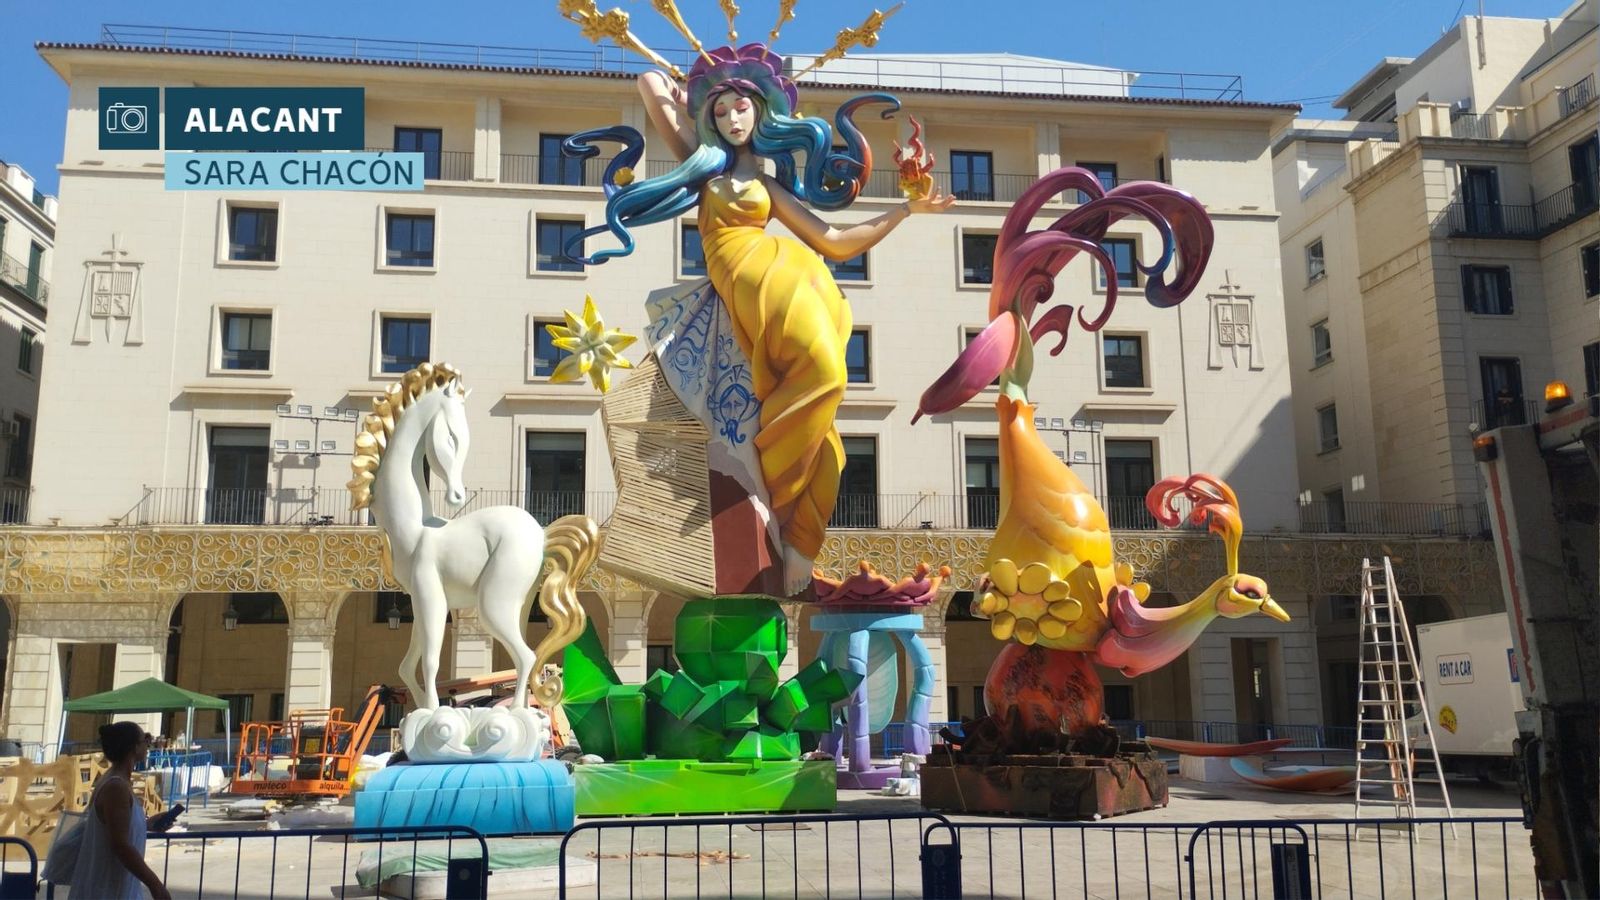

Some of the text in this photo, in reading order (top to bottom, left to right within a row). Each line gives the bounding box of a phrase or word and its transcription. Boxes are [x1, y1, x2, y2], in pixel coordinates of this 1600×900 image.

[1439, 660, 1472, 677] RENT A CAR
[253, 781, 287, 790] mateco
